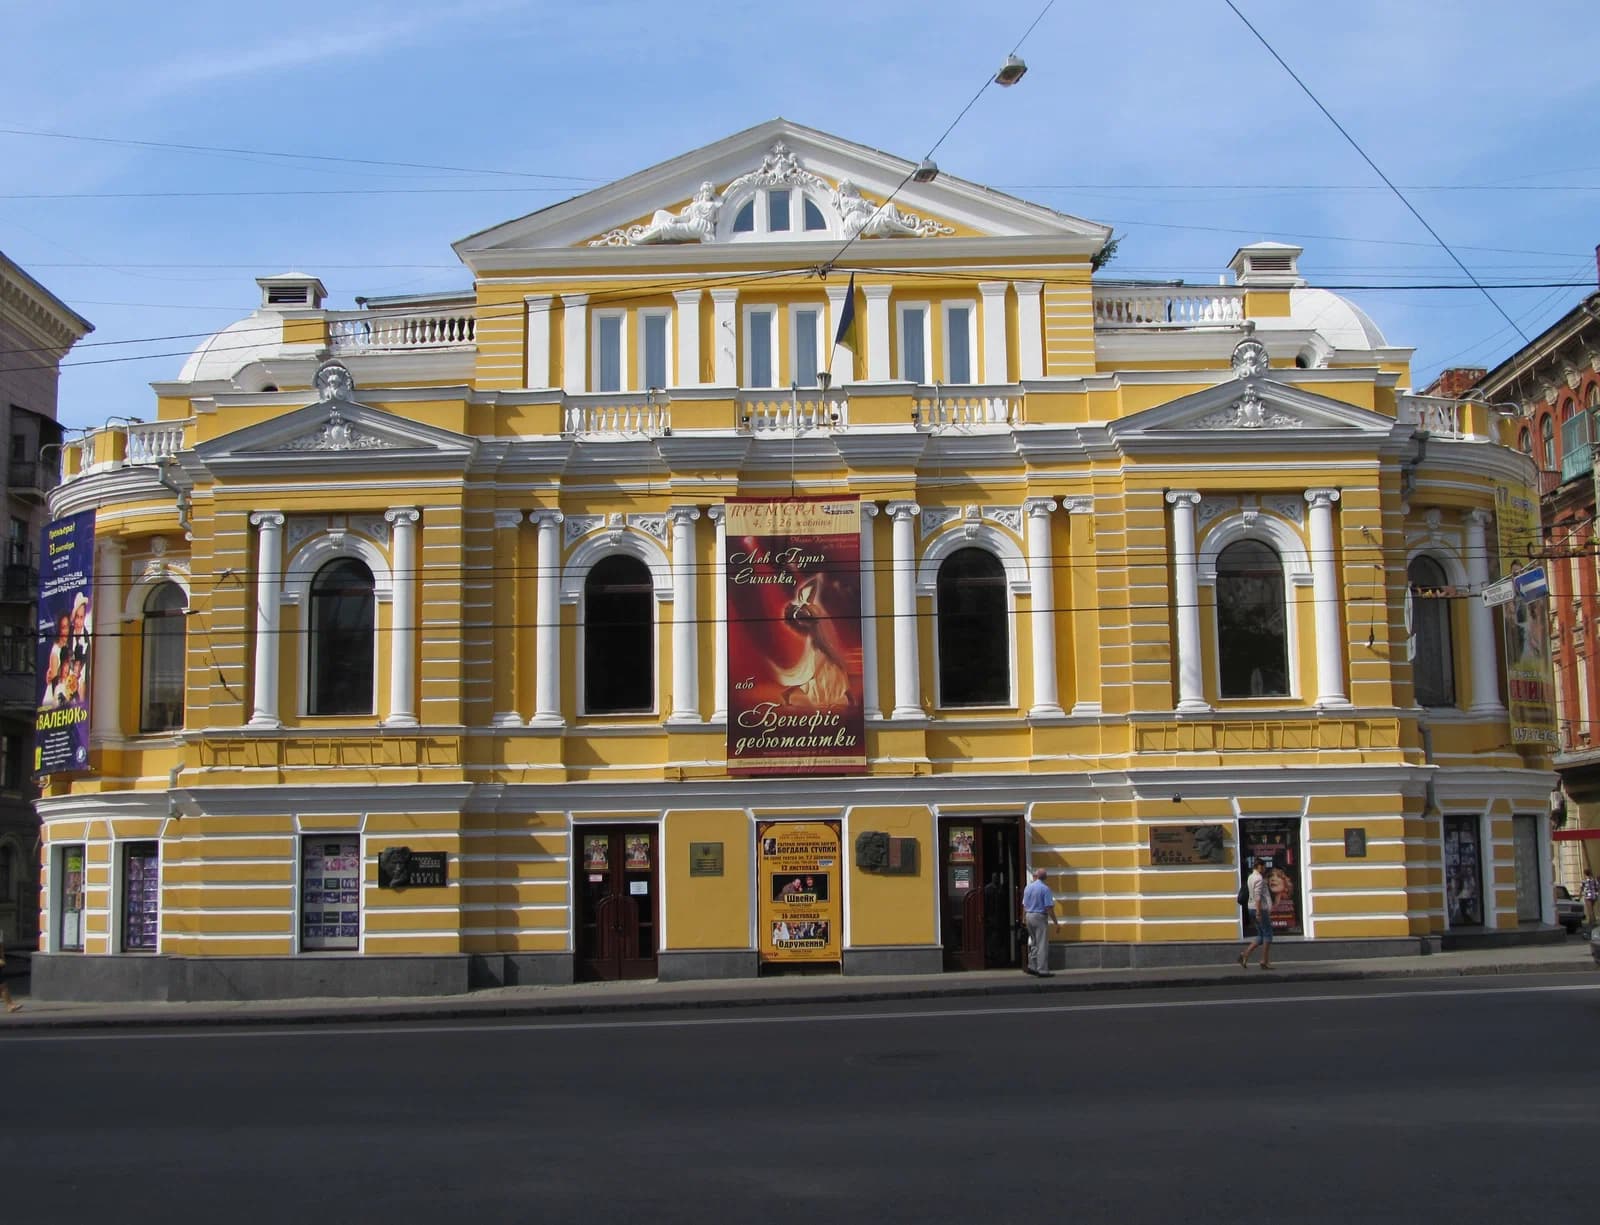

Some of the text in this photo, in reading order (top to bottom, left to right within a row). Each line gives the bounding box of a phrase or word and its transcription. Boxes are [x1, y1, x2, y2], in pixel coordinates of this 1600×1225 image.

[729, 547, 825, 569] Лев Гурич
[730, 568, 797, 586] Синичка,
[735, 677, 756, 690] або
[737, 702, 840, 733] Бенефіс
[734, 727, 857, 755] дебютантки
[811, 846, 837, 854] СТУПКИ
[786, 894, 815, 903] Швейк
[778, 940, 824, 948] Одруження
